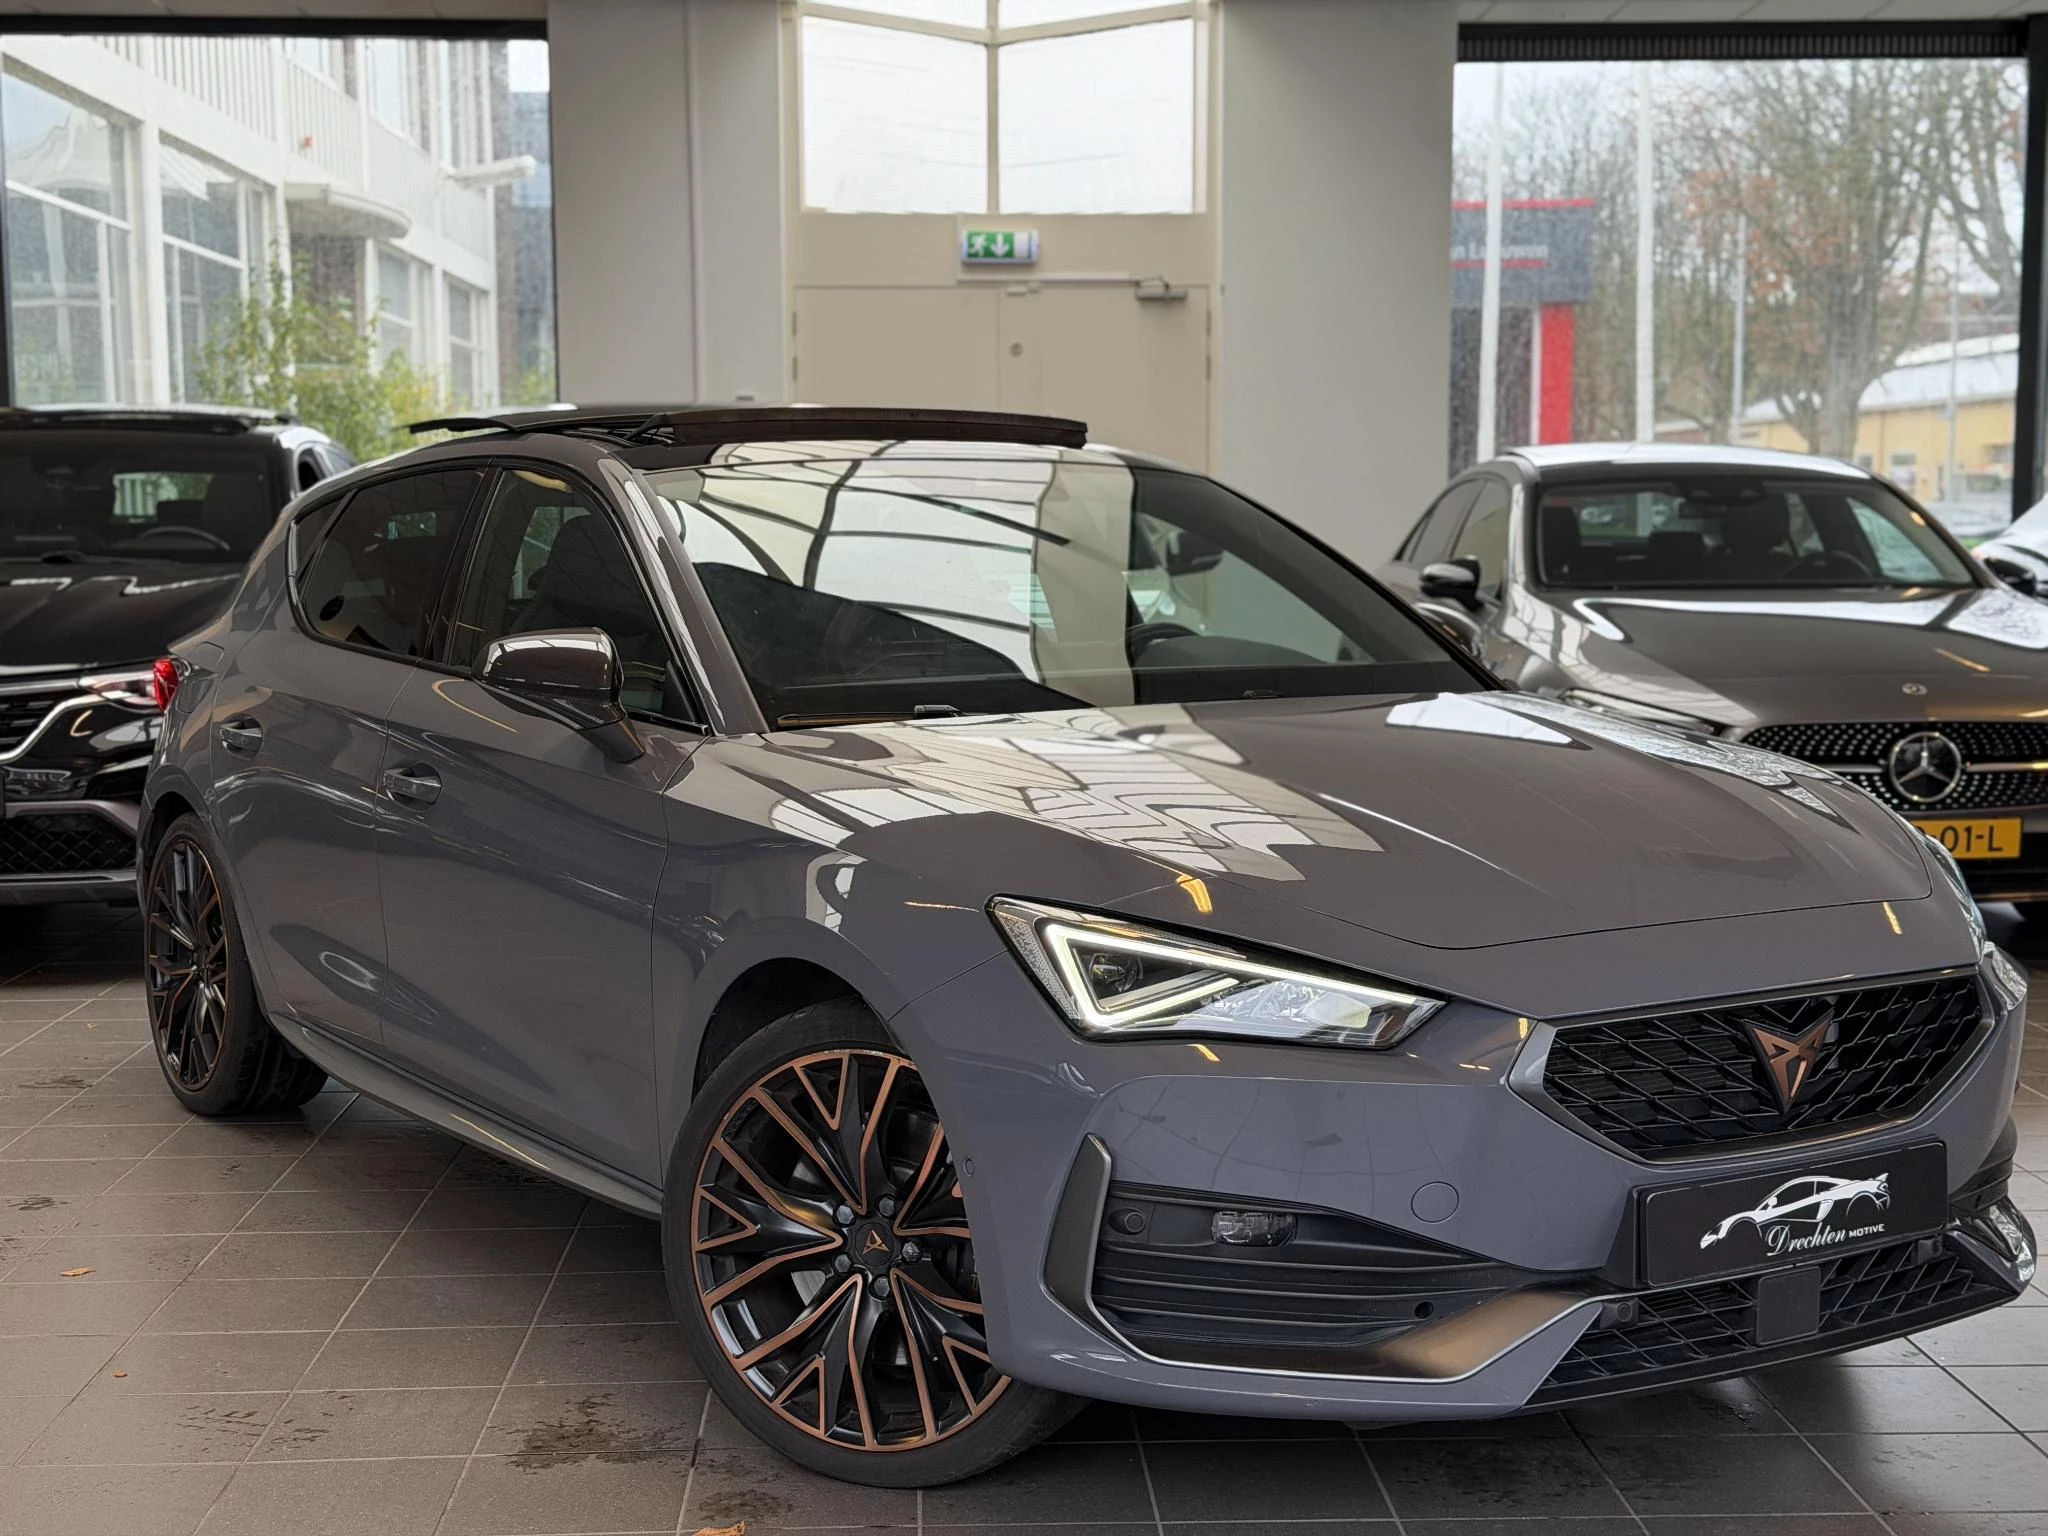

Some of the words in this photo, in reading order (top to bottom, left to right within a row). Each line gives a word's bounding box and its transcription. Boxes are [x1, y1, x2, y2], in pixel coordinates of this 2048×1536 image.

[1914, 825, 2003, 852] -01-L
[1765, 1221, 1846, 1256] Drechten
[1848, 1223, 1885, 1238] MOTIVE
